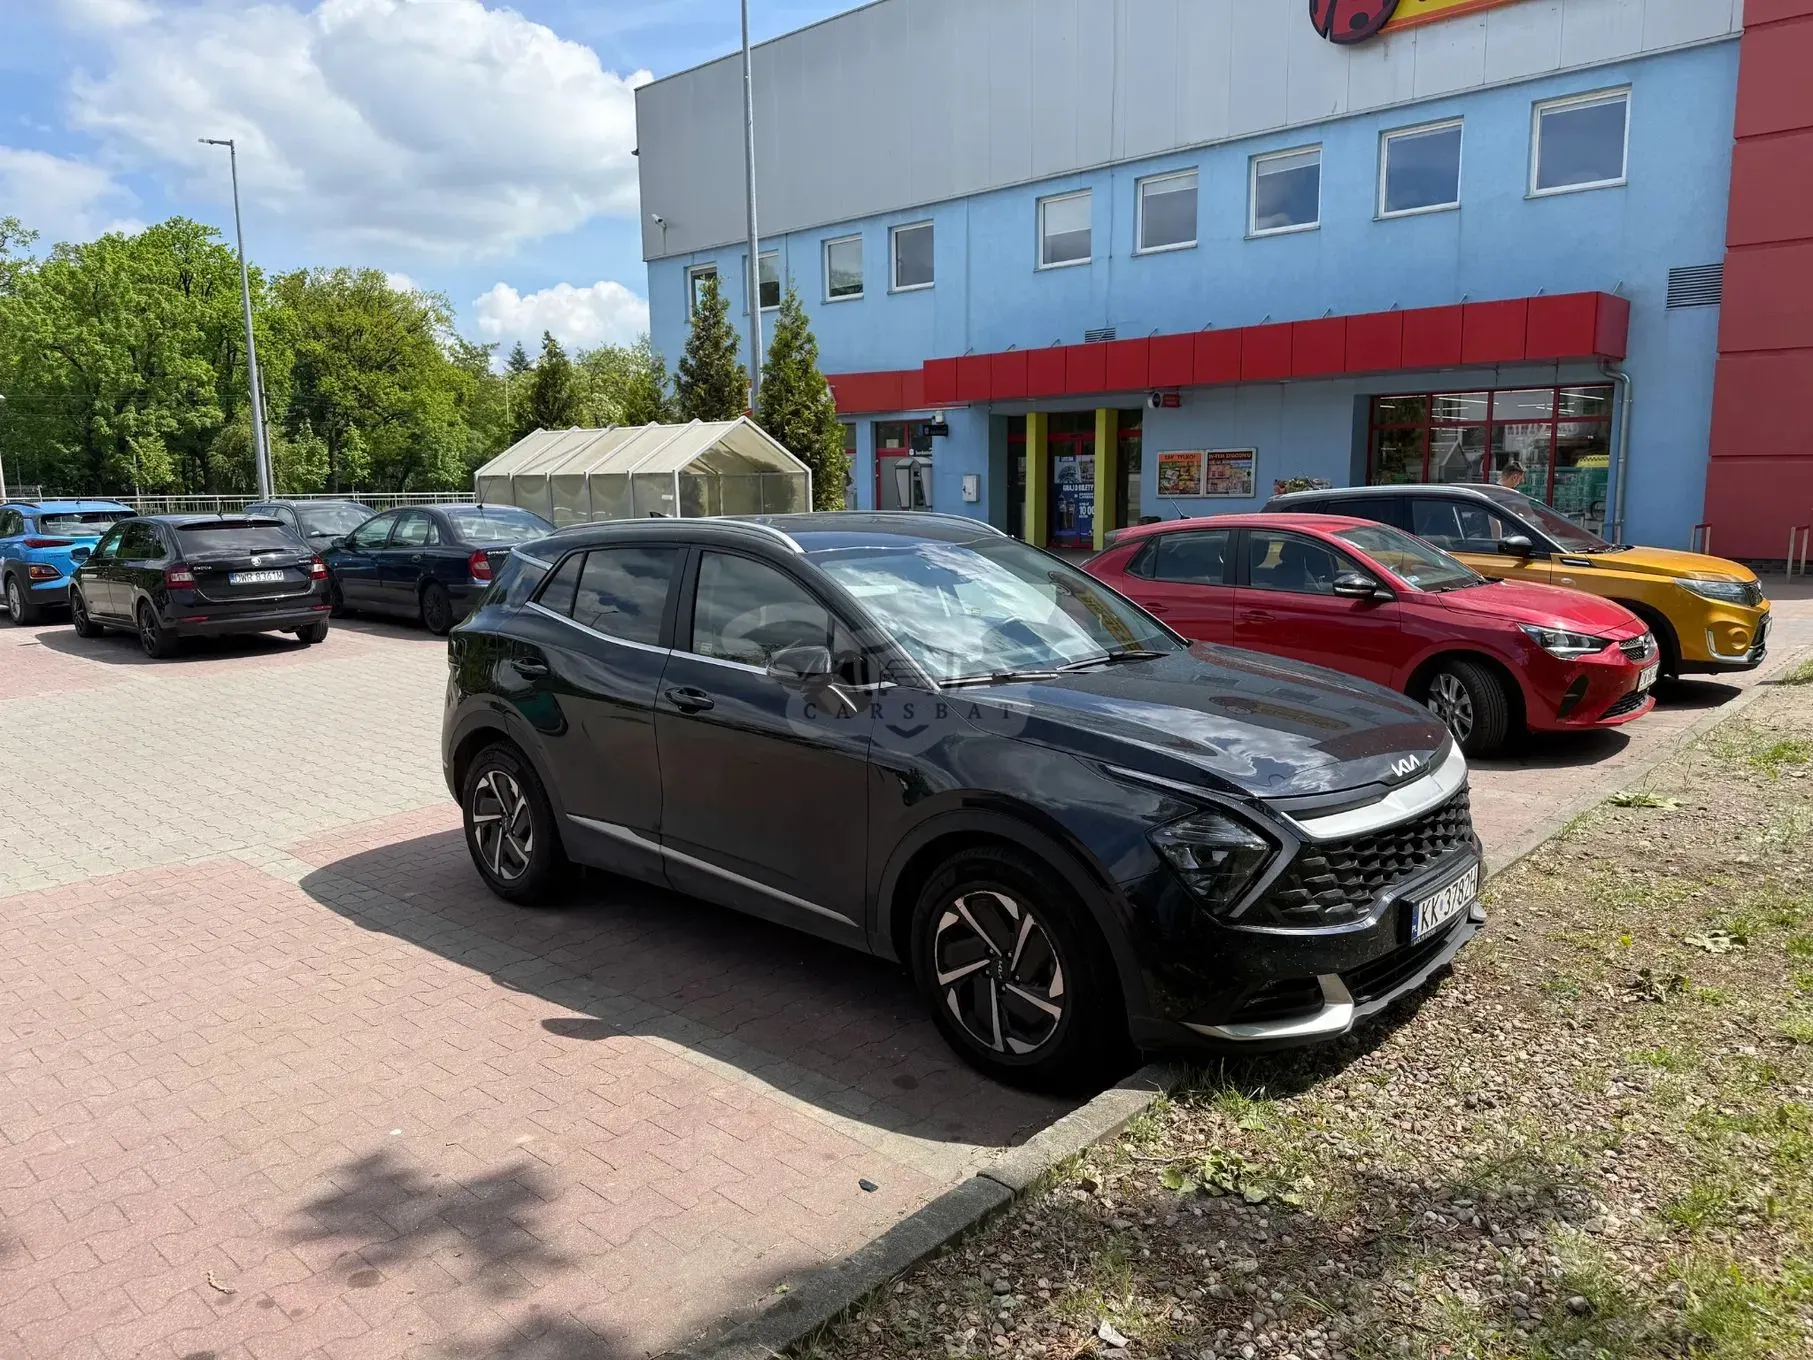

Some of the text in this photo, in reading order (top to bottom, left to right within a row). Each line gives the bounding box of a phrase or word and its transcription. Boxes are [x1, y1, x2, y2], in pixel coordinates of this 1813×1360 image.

[234, 573, 254, 583] DWR
[1391, 754, 1421, 777] KIA
[1420, 864, 1478, 932] KK 3782H
